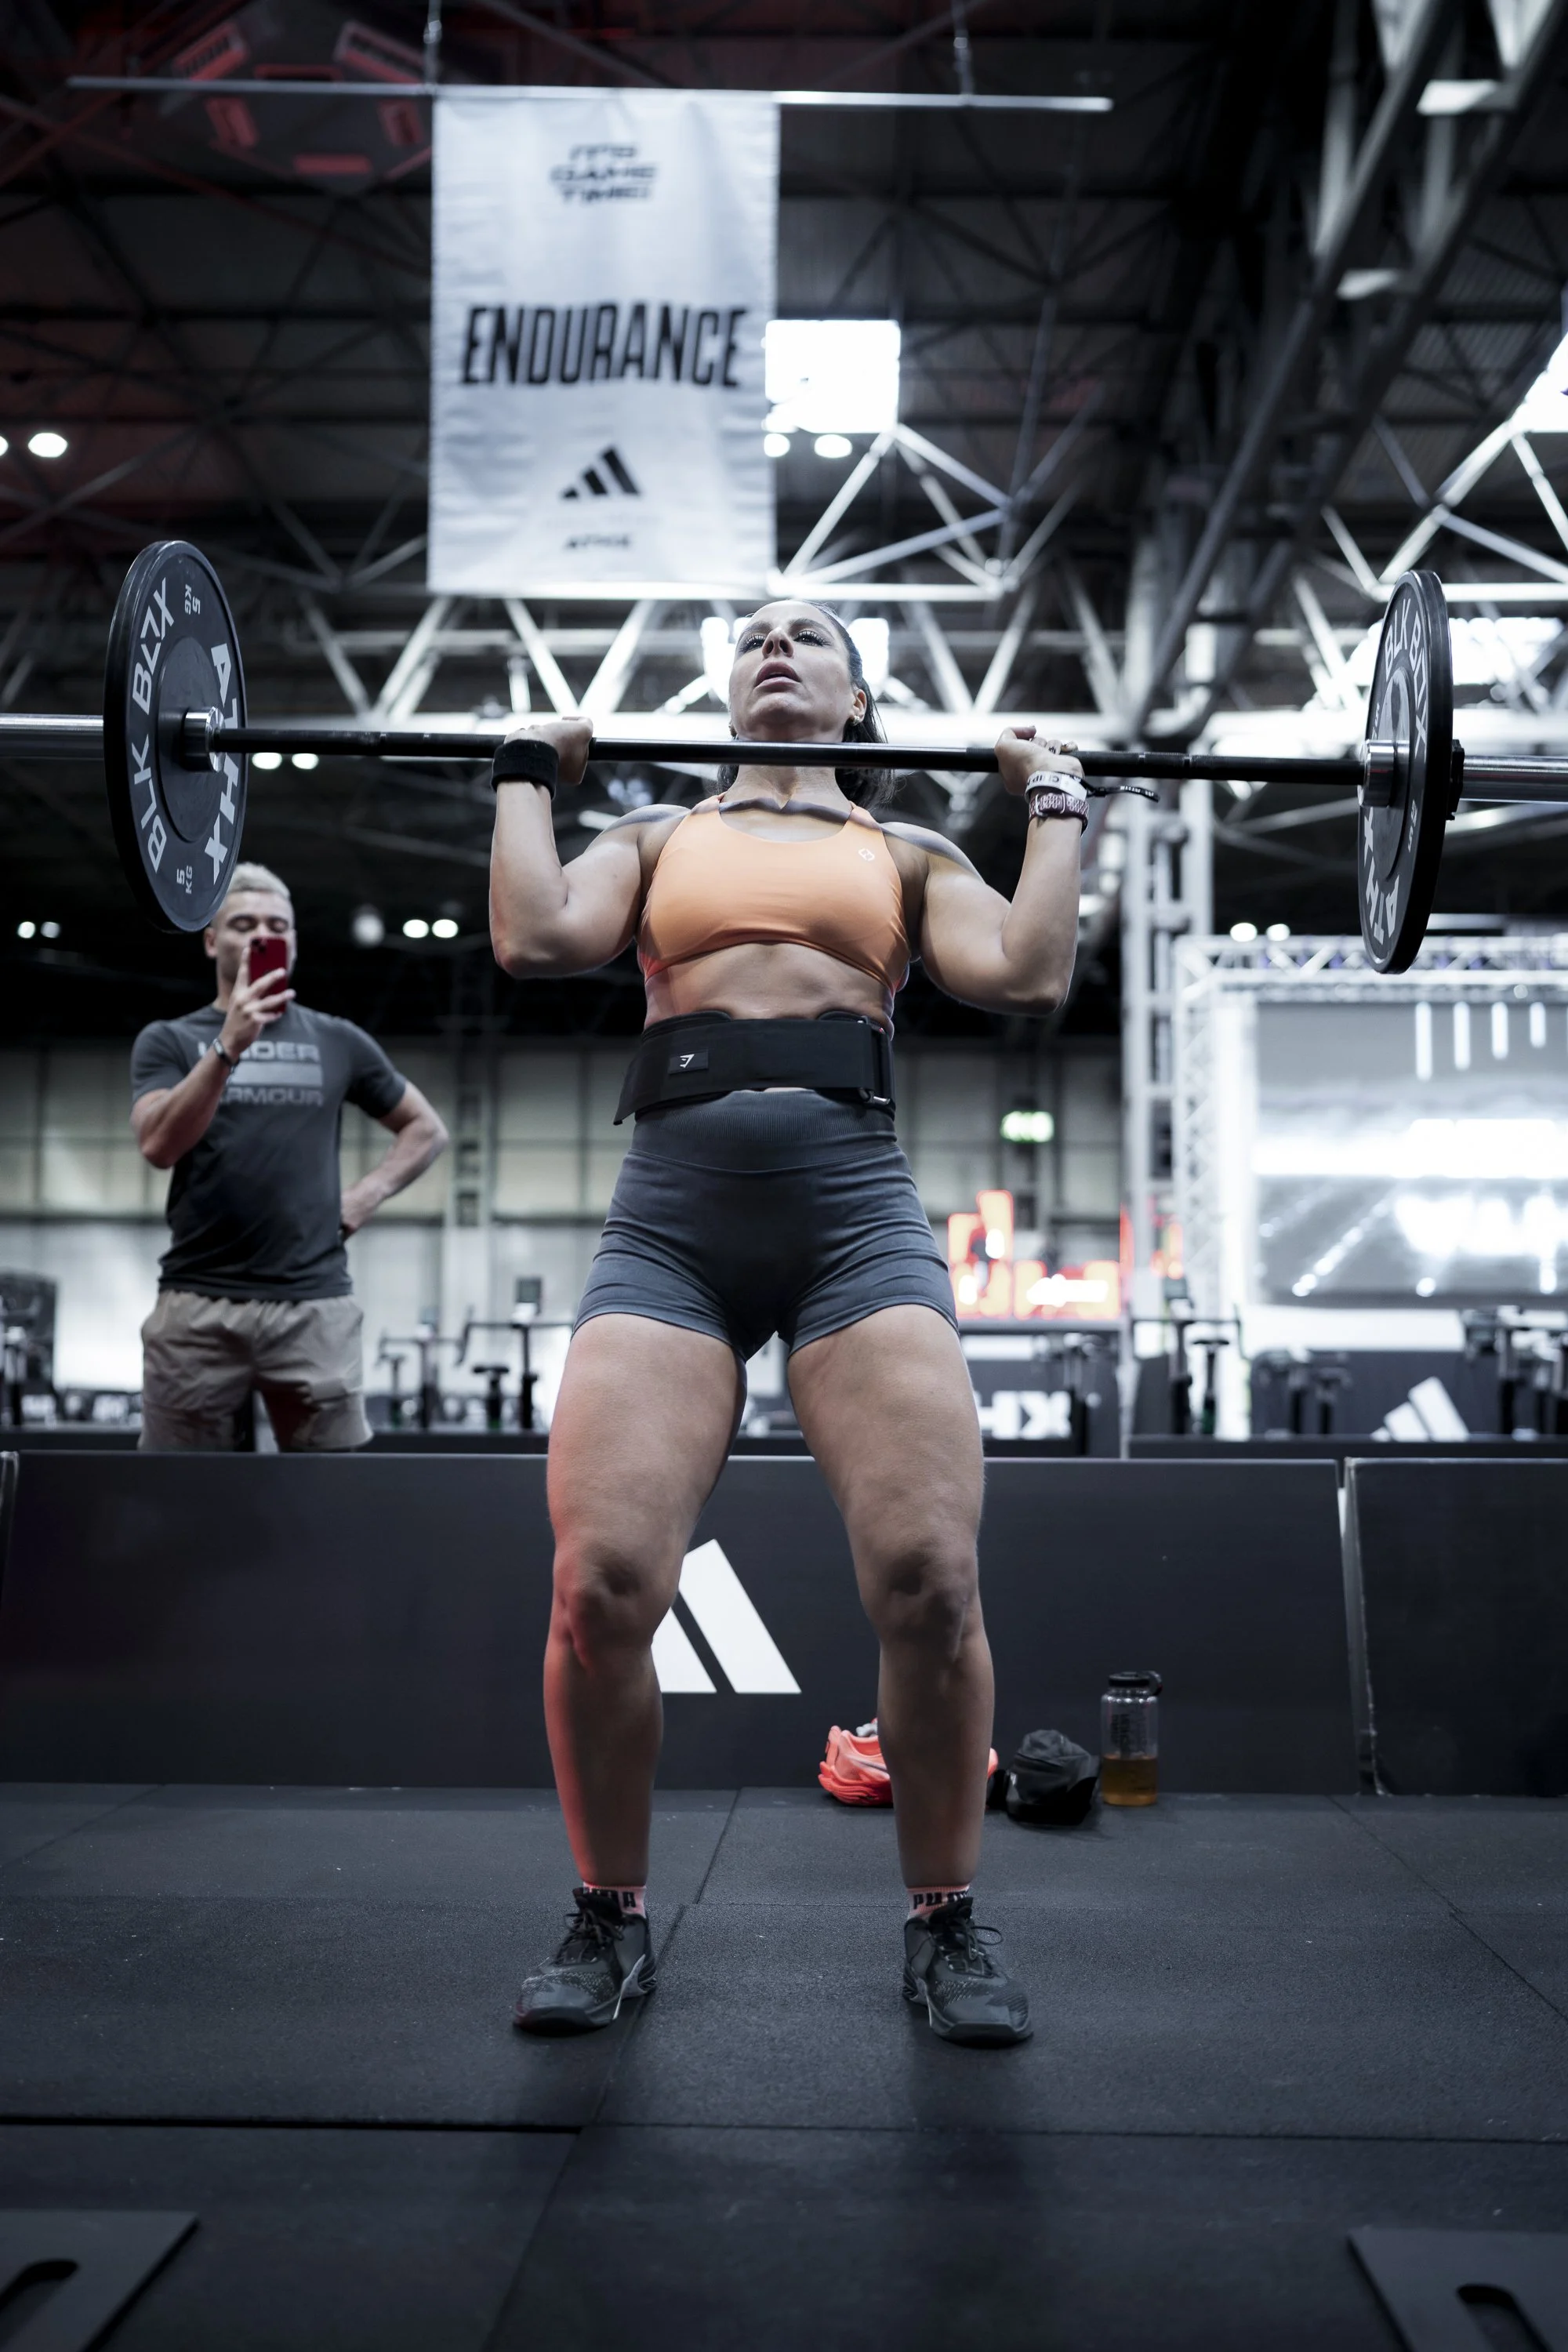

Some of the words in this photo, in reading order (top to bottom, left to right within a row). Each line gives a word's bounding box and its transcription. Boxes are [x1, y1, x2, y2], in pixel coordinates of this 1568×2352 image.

[460, 303, 747, 387] ENDURANCE
[185, 583, 192, 615] KG
[1385, 598, 1411, 682] BLK
[132, 734, 167, 873] BLK
[185, 865, 193, 895] KG
[198, 1040, 320, 1062] DER
